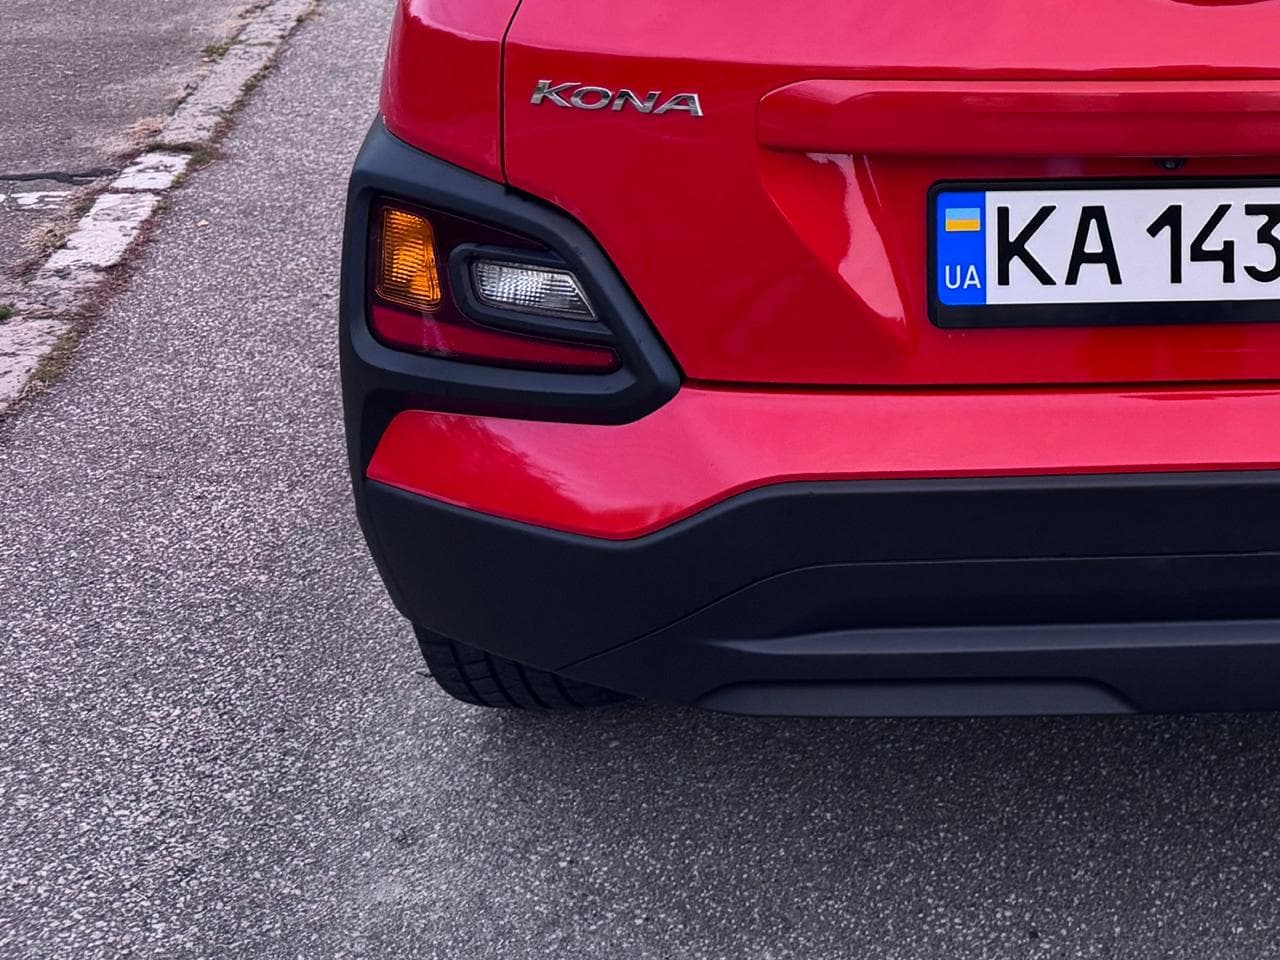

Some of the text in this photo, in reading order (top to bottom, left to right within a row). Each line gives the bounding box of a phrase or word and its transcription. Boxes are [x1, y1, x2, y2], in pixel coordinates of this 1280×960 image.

[530, 79, 704, 117] KONA
[996, 205, 1122, 287] KA
[945, 266, 981, 290] UA
